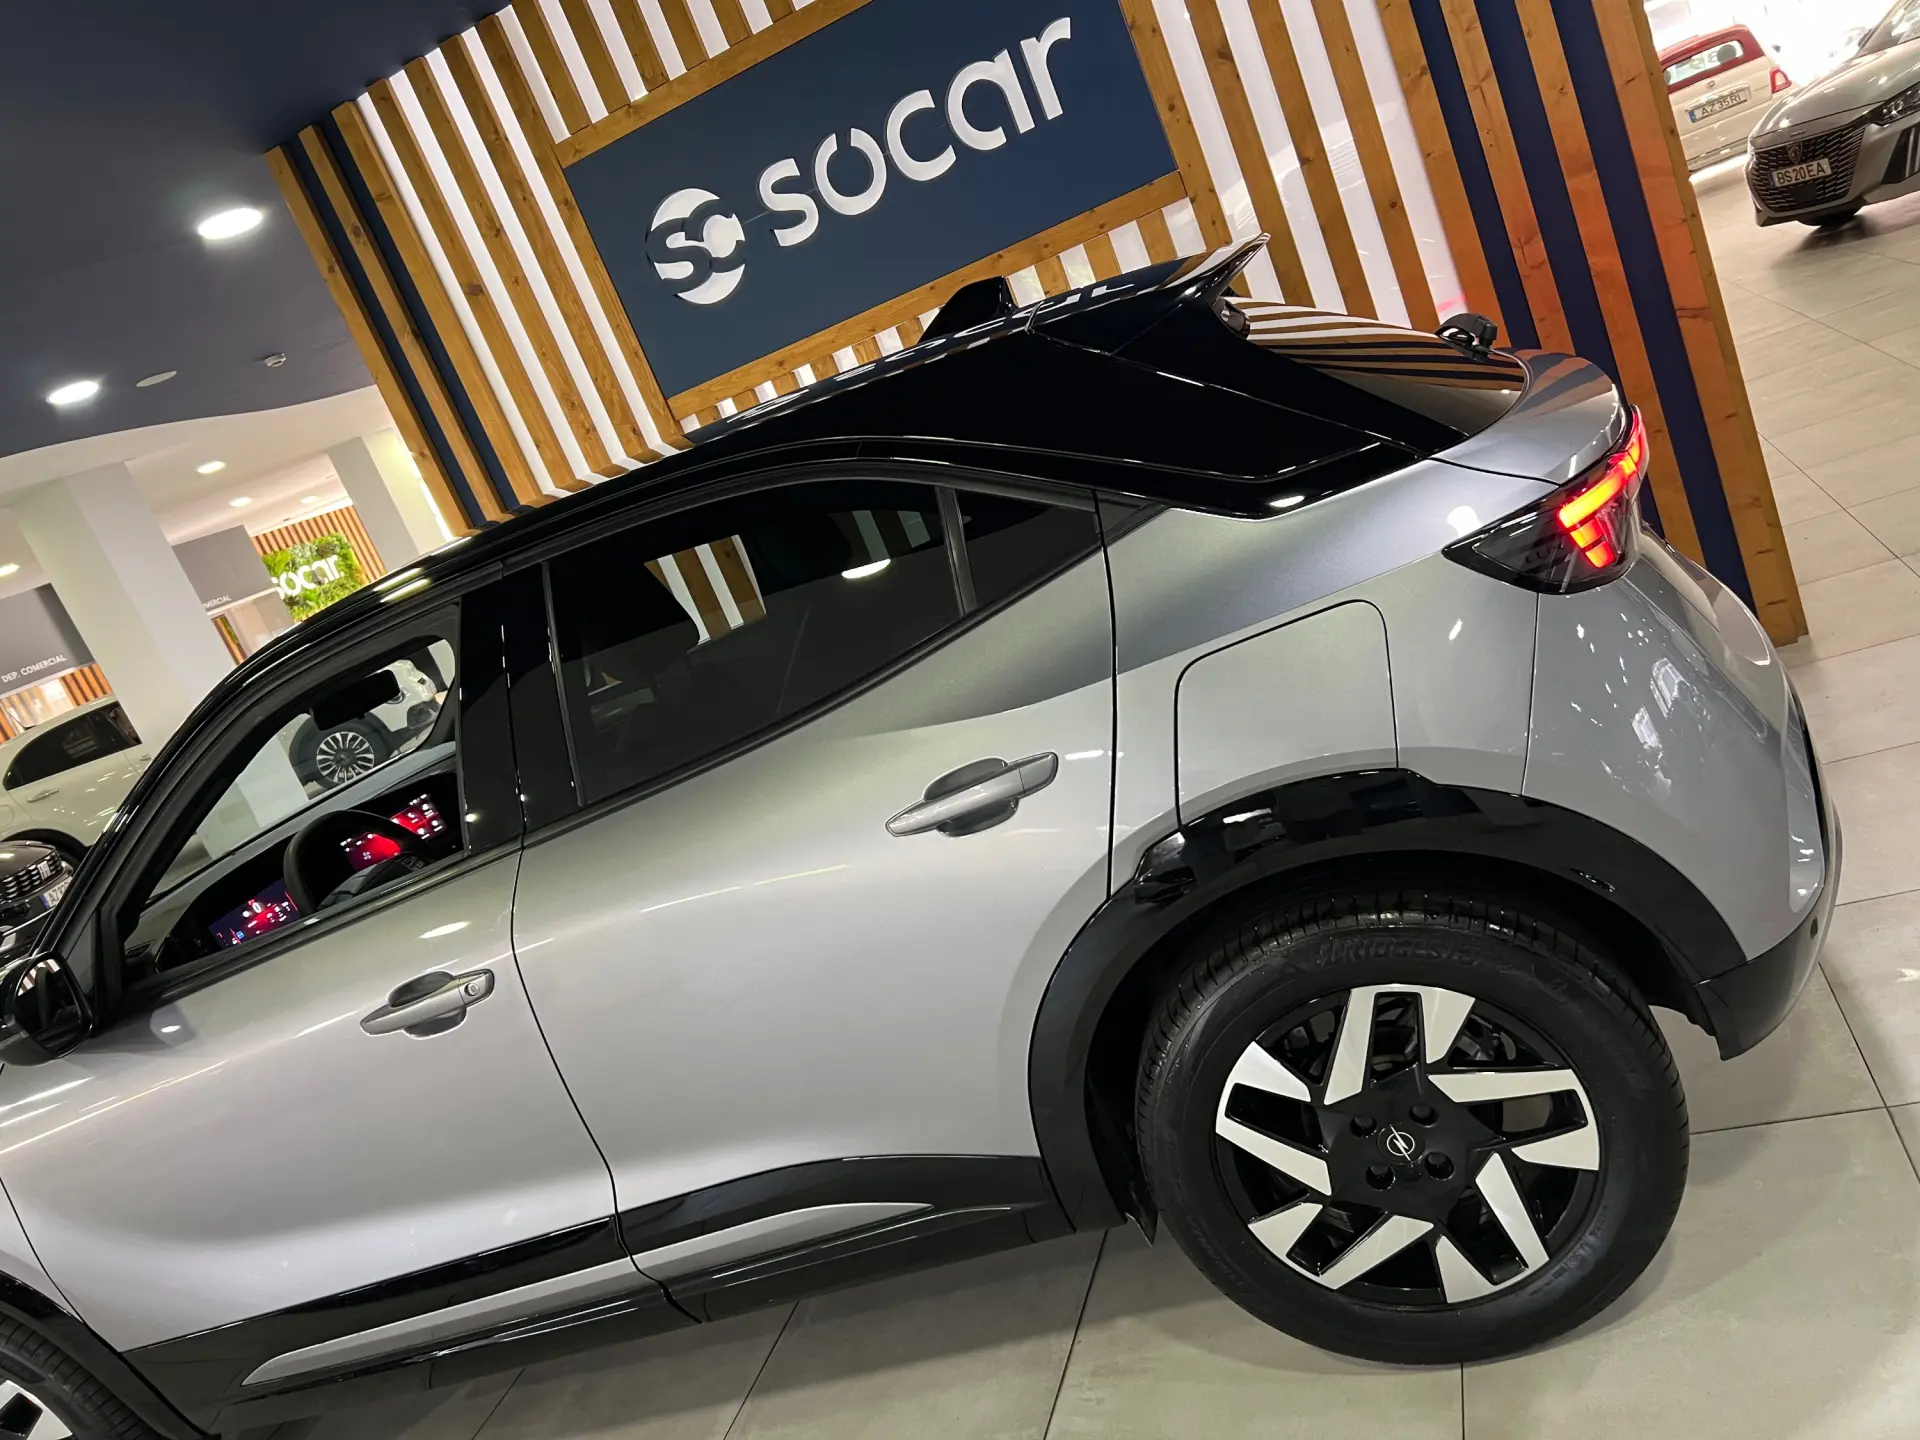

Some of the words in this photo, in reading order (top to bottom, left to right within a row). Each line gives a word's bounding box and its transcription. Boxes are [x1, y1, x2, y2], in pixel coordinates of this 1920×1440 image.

[756, 16, 1072, 248] socar
[1776, 162, 1826, 185] BS20EA
[20, 654, 67, 675] COMERCIAL
